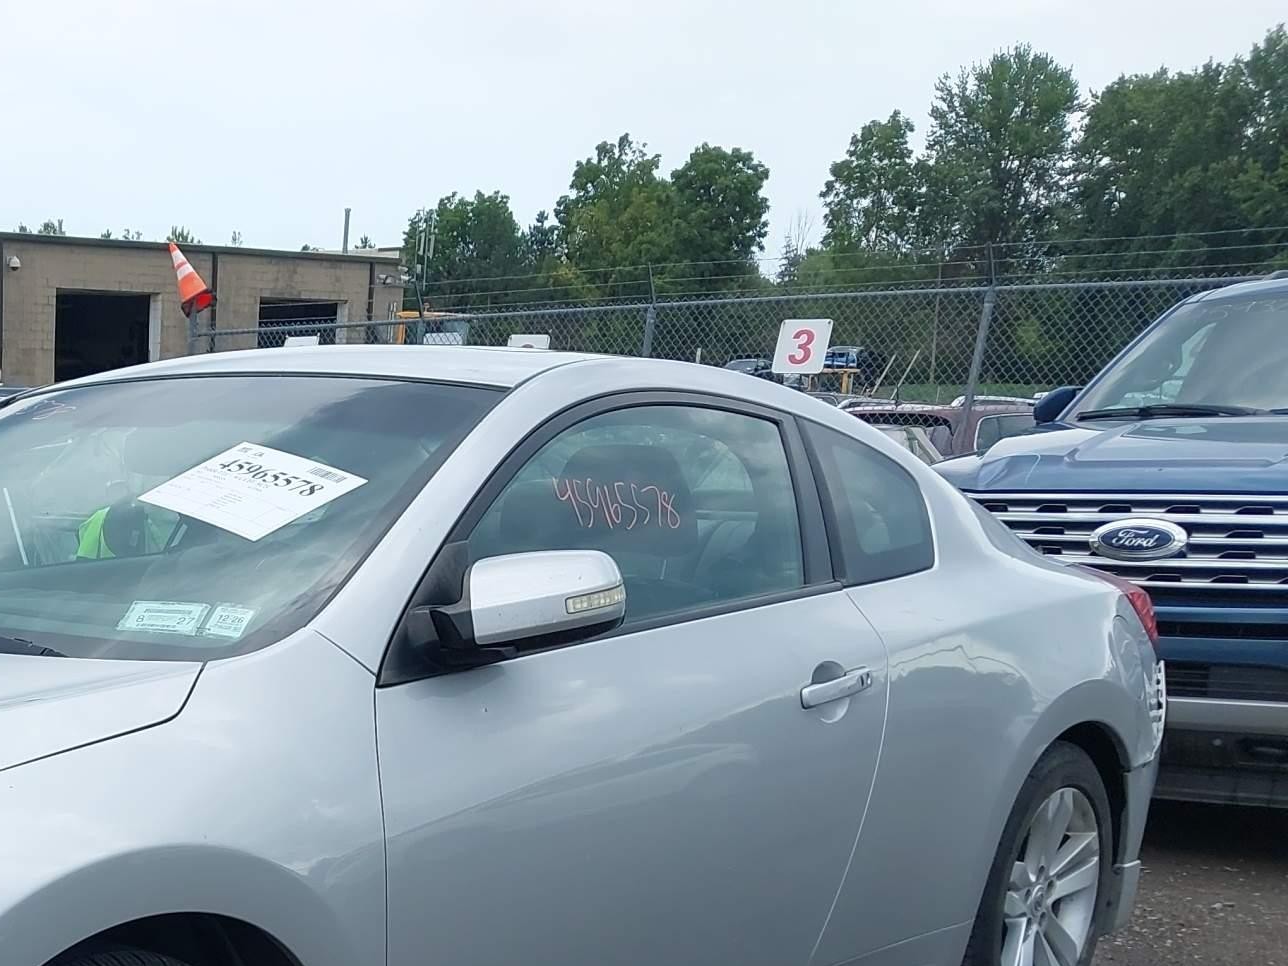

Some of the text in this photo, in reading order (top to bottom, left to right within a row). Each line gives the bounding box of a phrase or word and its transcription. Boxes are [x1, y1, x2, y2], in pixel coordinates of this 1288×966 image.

[788, 329, 815, 365] 3
[219, 459, 324, 496] 45965578
[552, 476, 681, 530] 45965578
[1112, 528, 1160, 548] Ford
